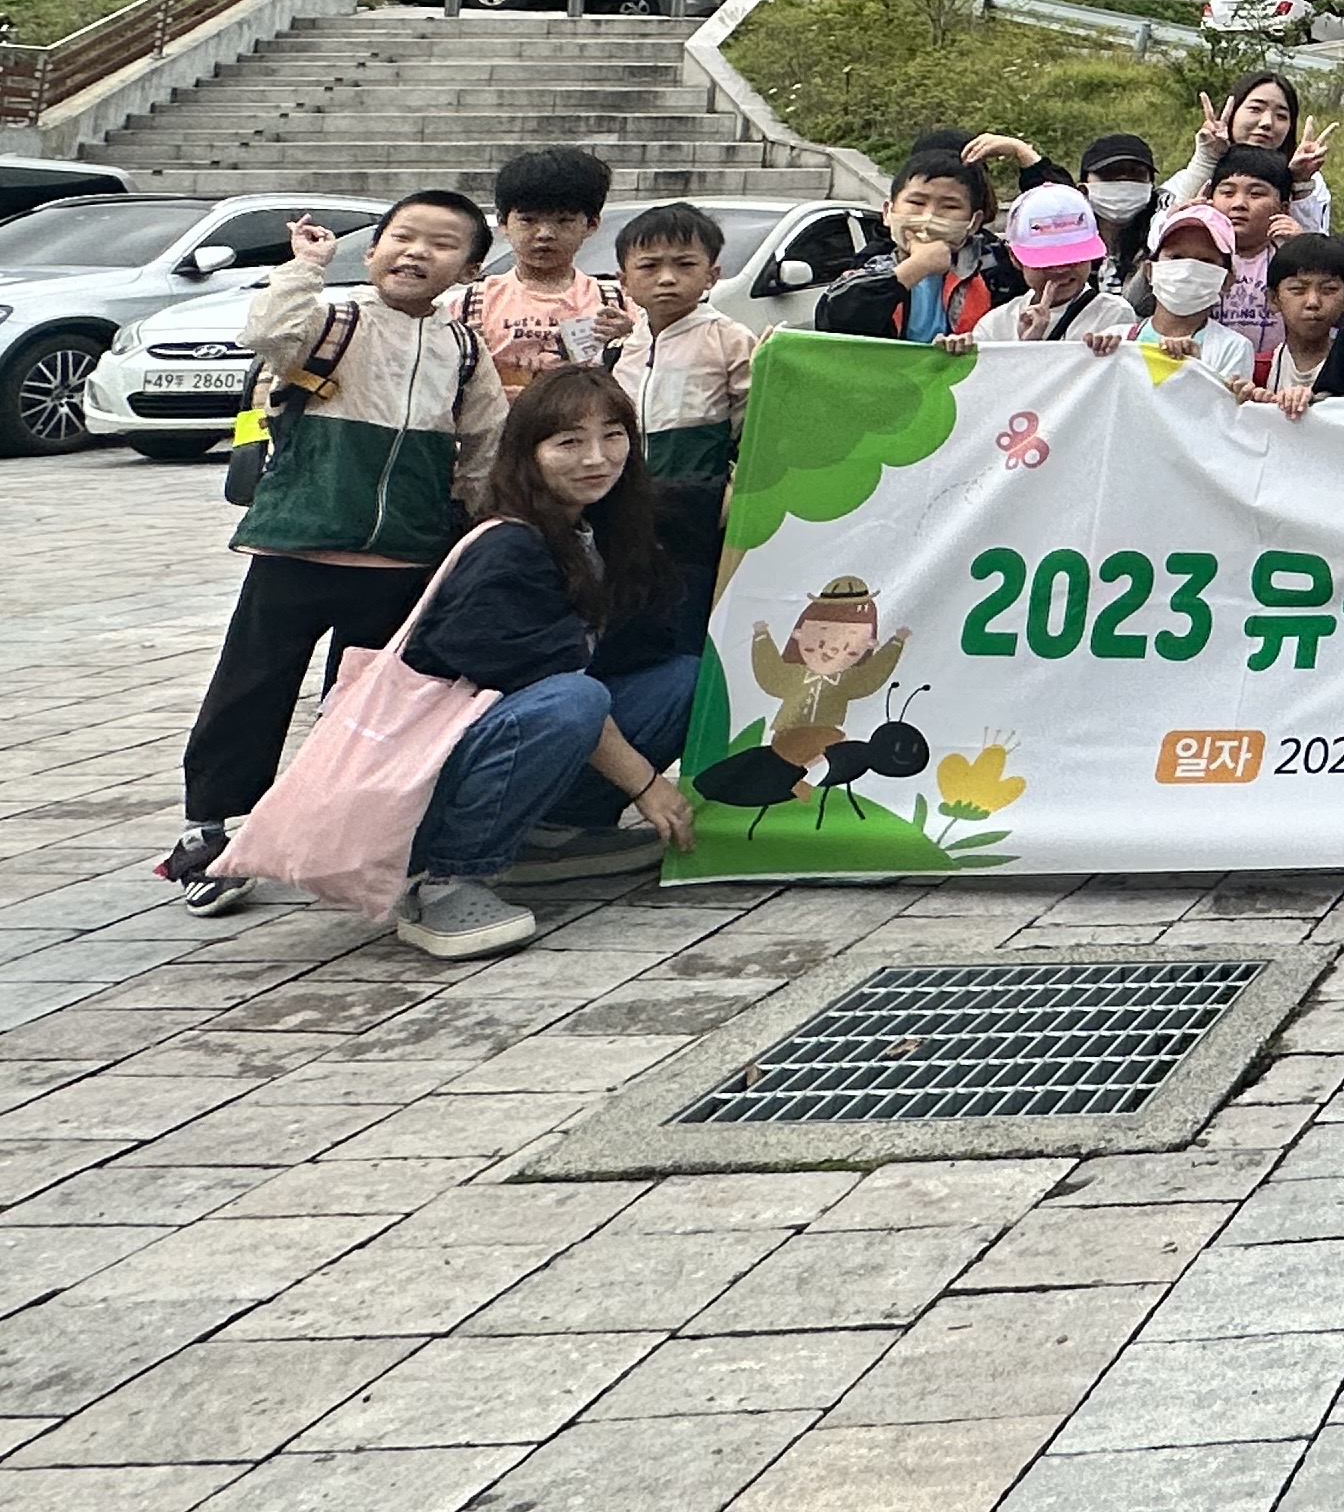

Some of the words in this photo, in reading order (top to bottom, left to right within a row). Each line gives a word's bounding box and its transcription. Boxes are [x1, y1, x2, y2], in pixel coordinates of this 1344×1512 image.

[192, 373, 235, 389] 2860
[961, 547, 1218, 661] 2023
[1174, 736, 1252, 778] 일자
